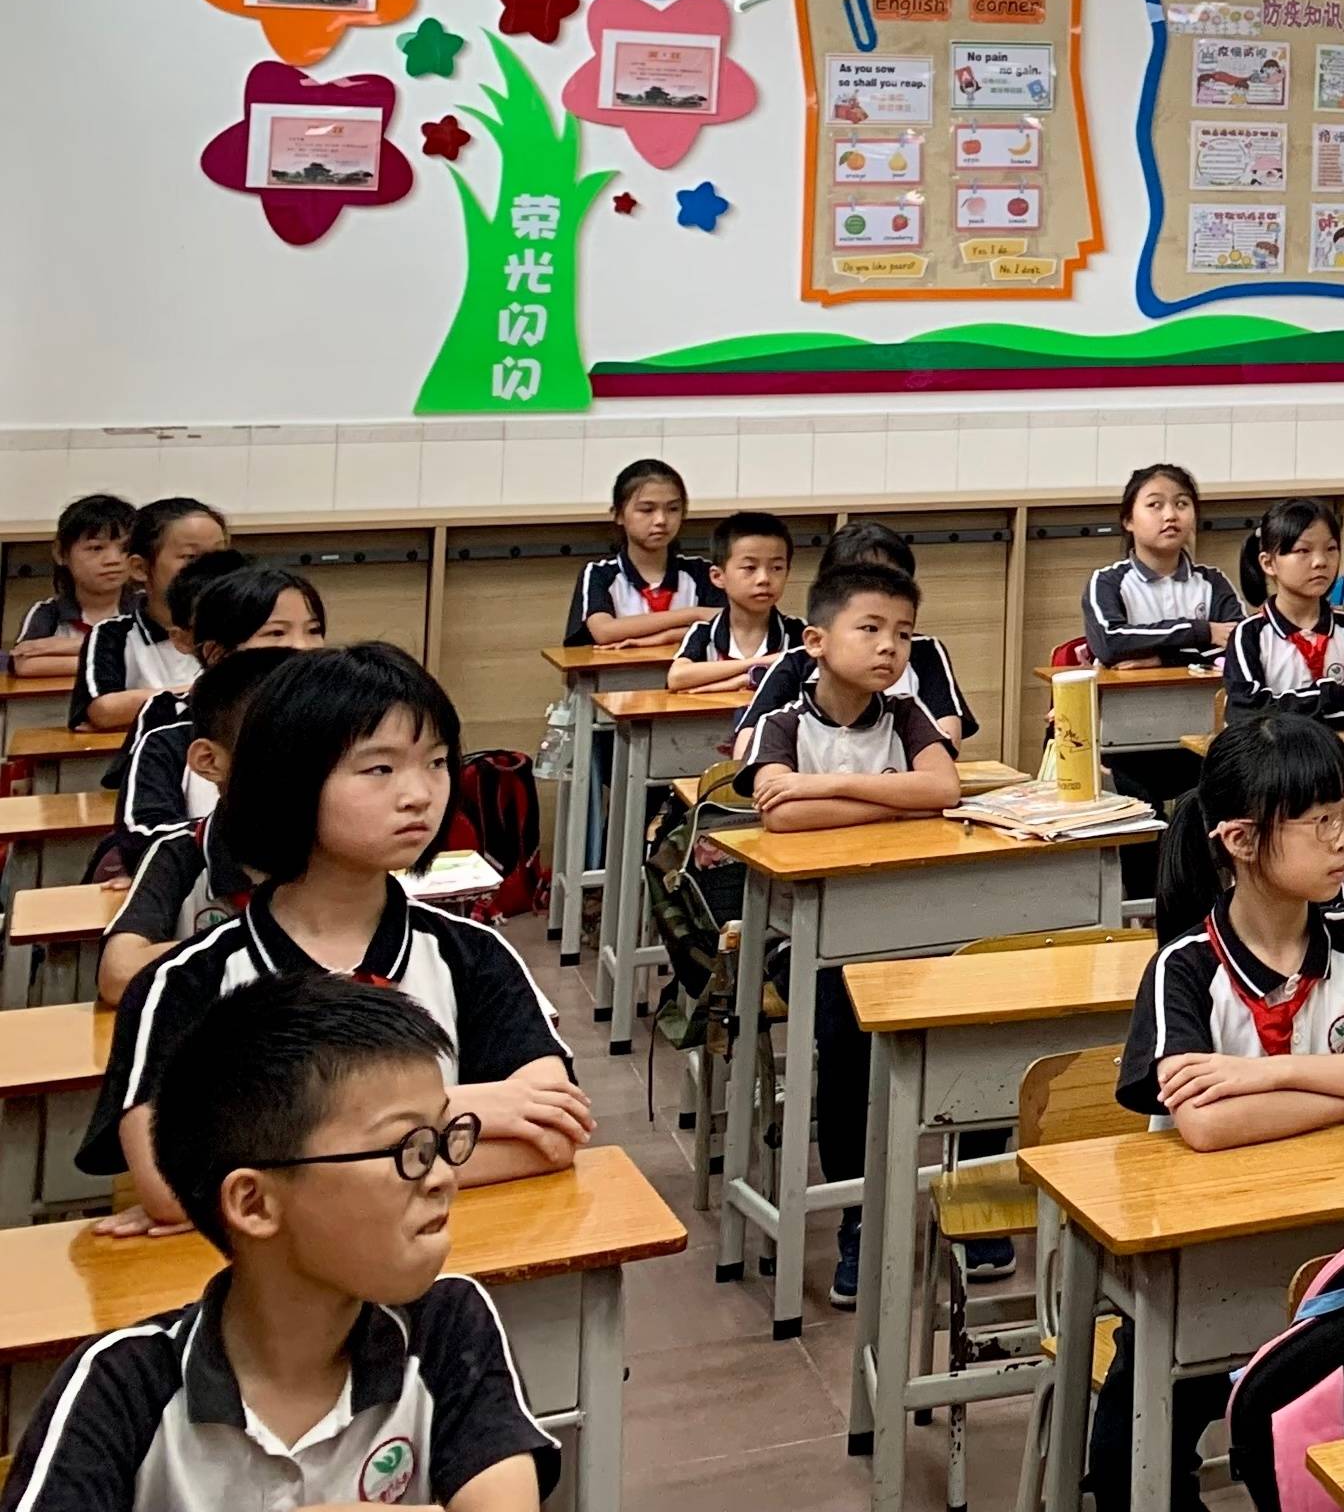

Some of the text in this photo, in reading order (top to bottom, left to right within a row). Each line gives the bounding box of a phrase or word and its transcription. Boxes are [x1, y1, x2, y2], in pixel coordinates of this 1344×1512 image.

[967, 51, 1008, 63] No pain
[840, 63, 852, 72] As
[855, 66, 872, 74] you
[854, 78, 877, 87] shall
[880, 80, 897, 89] you
[491, 193, 561, 401] 荣光闪闪
